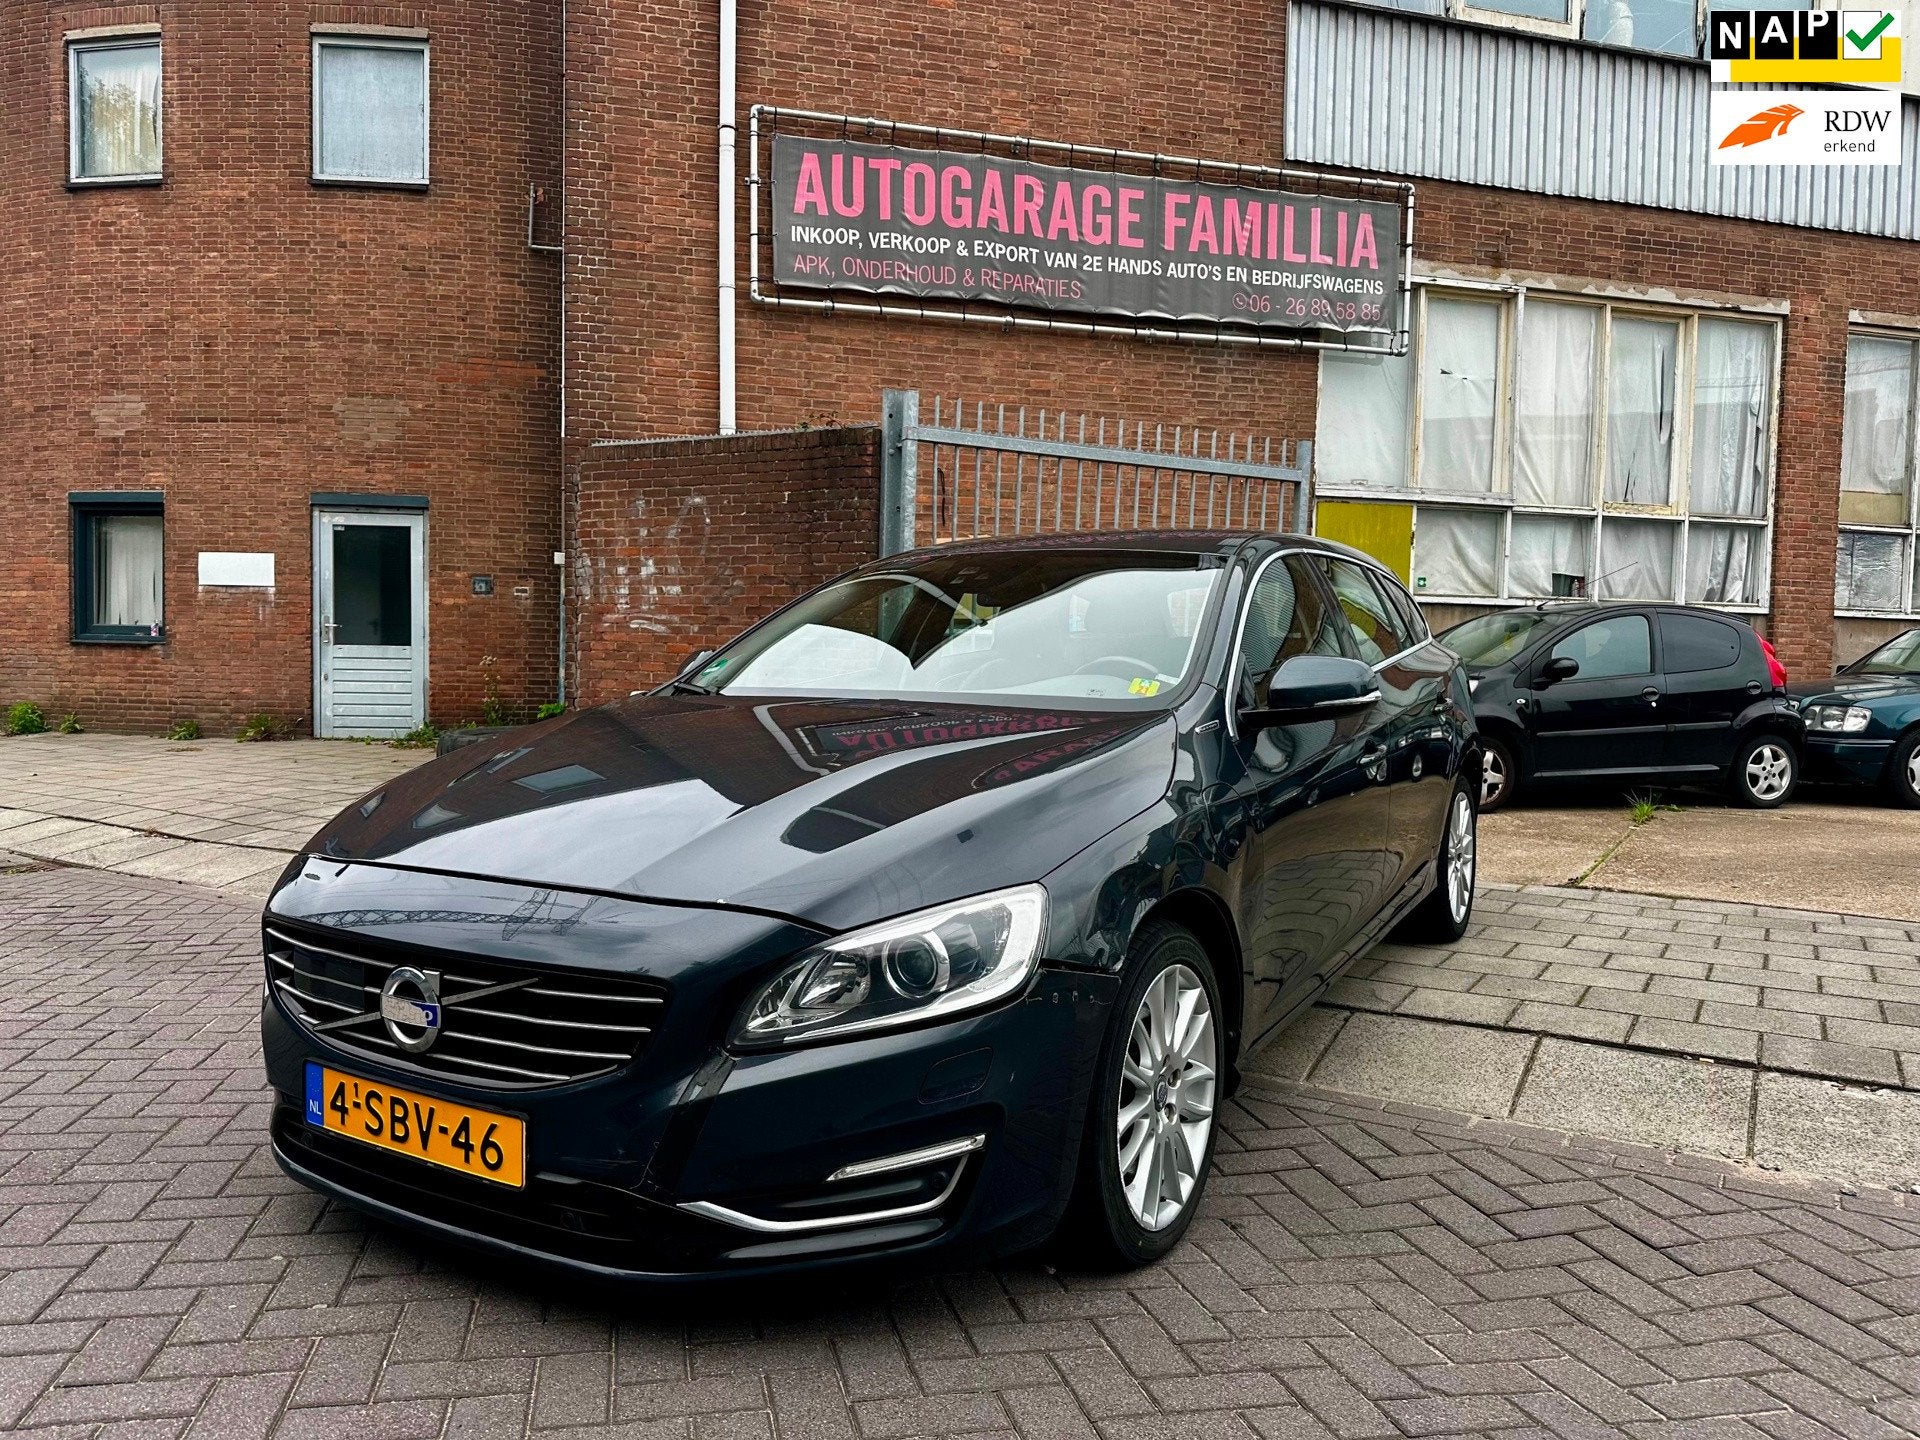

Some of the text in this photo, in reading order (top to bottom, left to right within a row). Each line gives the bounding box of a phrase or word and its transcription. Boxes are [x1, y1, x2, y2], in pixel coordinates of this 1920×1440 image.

[793, 152, 1379, 269] AUTOGARAGE FAMILLIA
[791, 225, 1384, 295] INKOOP, VERKOOP & EXPORT VAN 2E HANDS AUTO'S EN BEDRIJFSWAGENS
[793, 254, 1082, 299] APK, ONDERHOUD & REPARATIES
[1250, 294, 1271, 313] 06
[1285, 297, 1305, 316] 26
[1311, 299, 1330, 317] 89
[1336, 301, 1356, 319] 58
[1361, 303, 1381, 321] 85
[309, 1098, 322, 1116] NL
